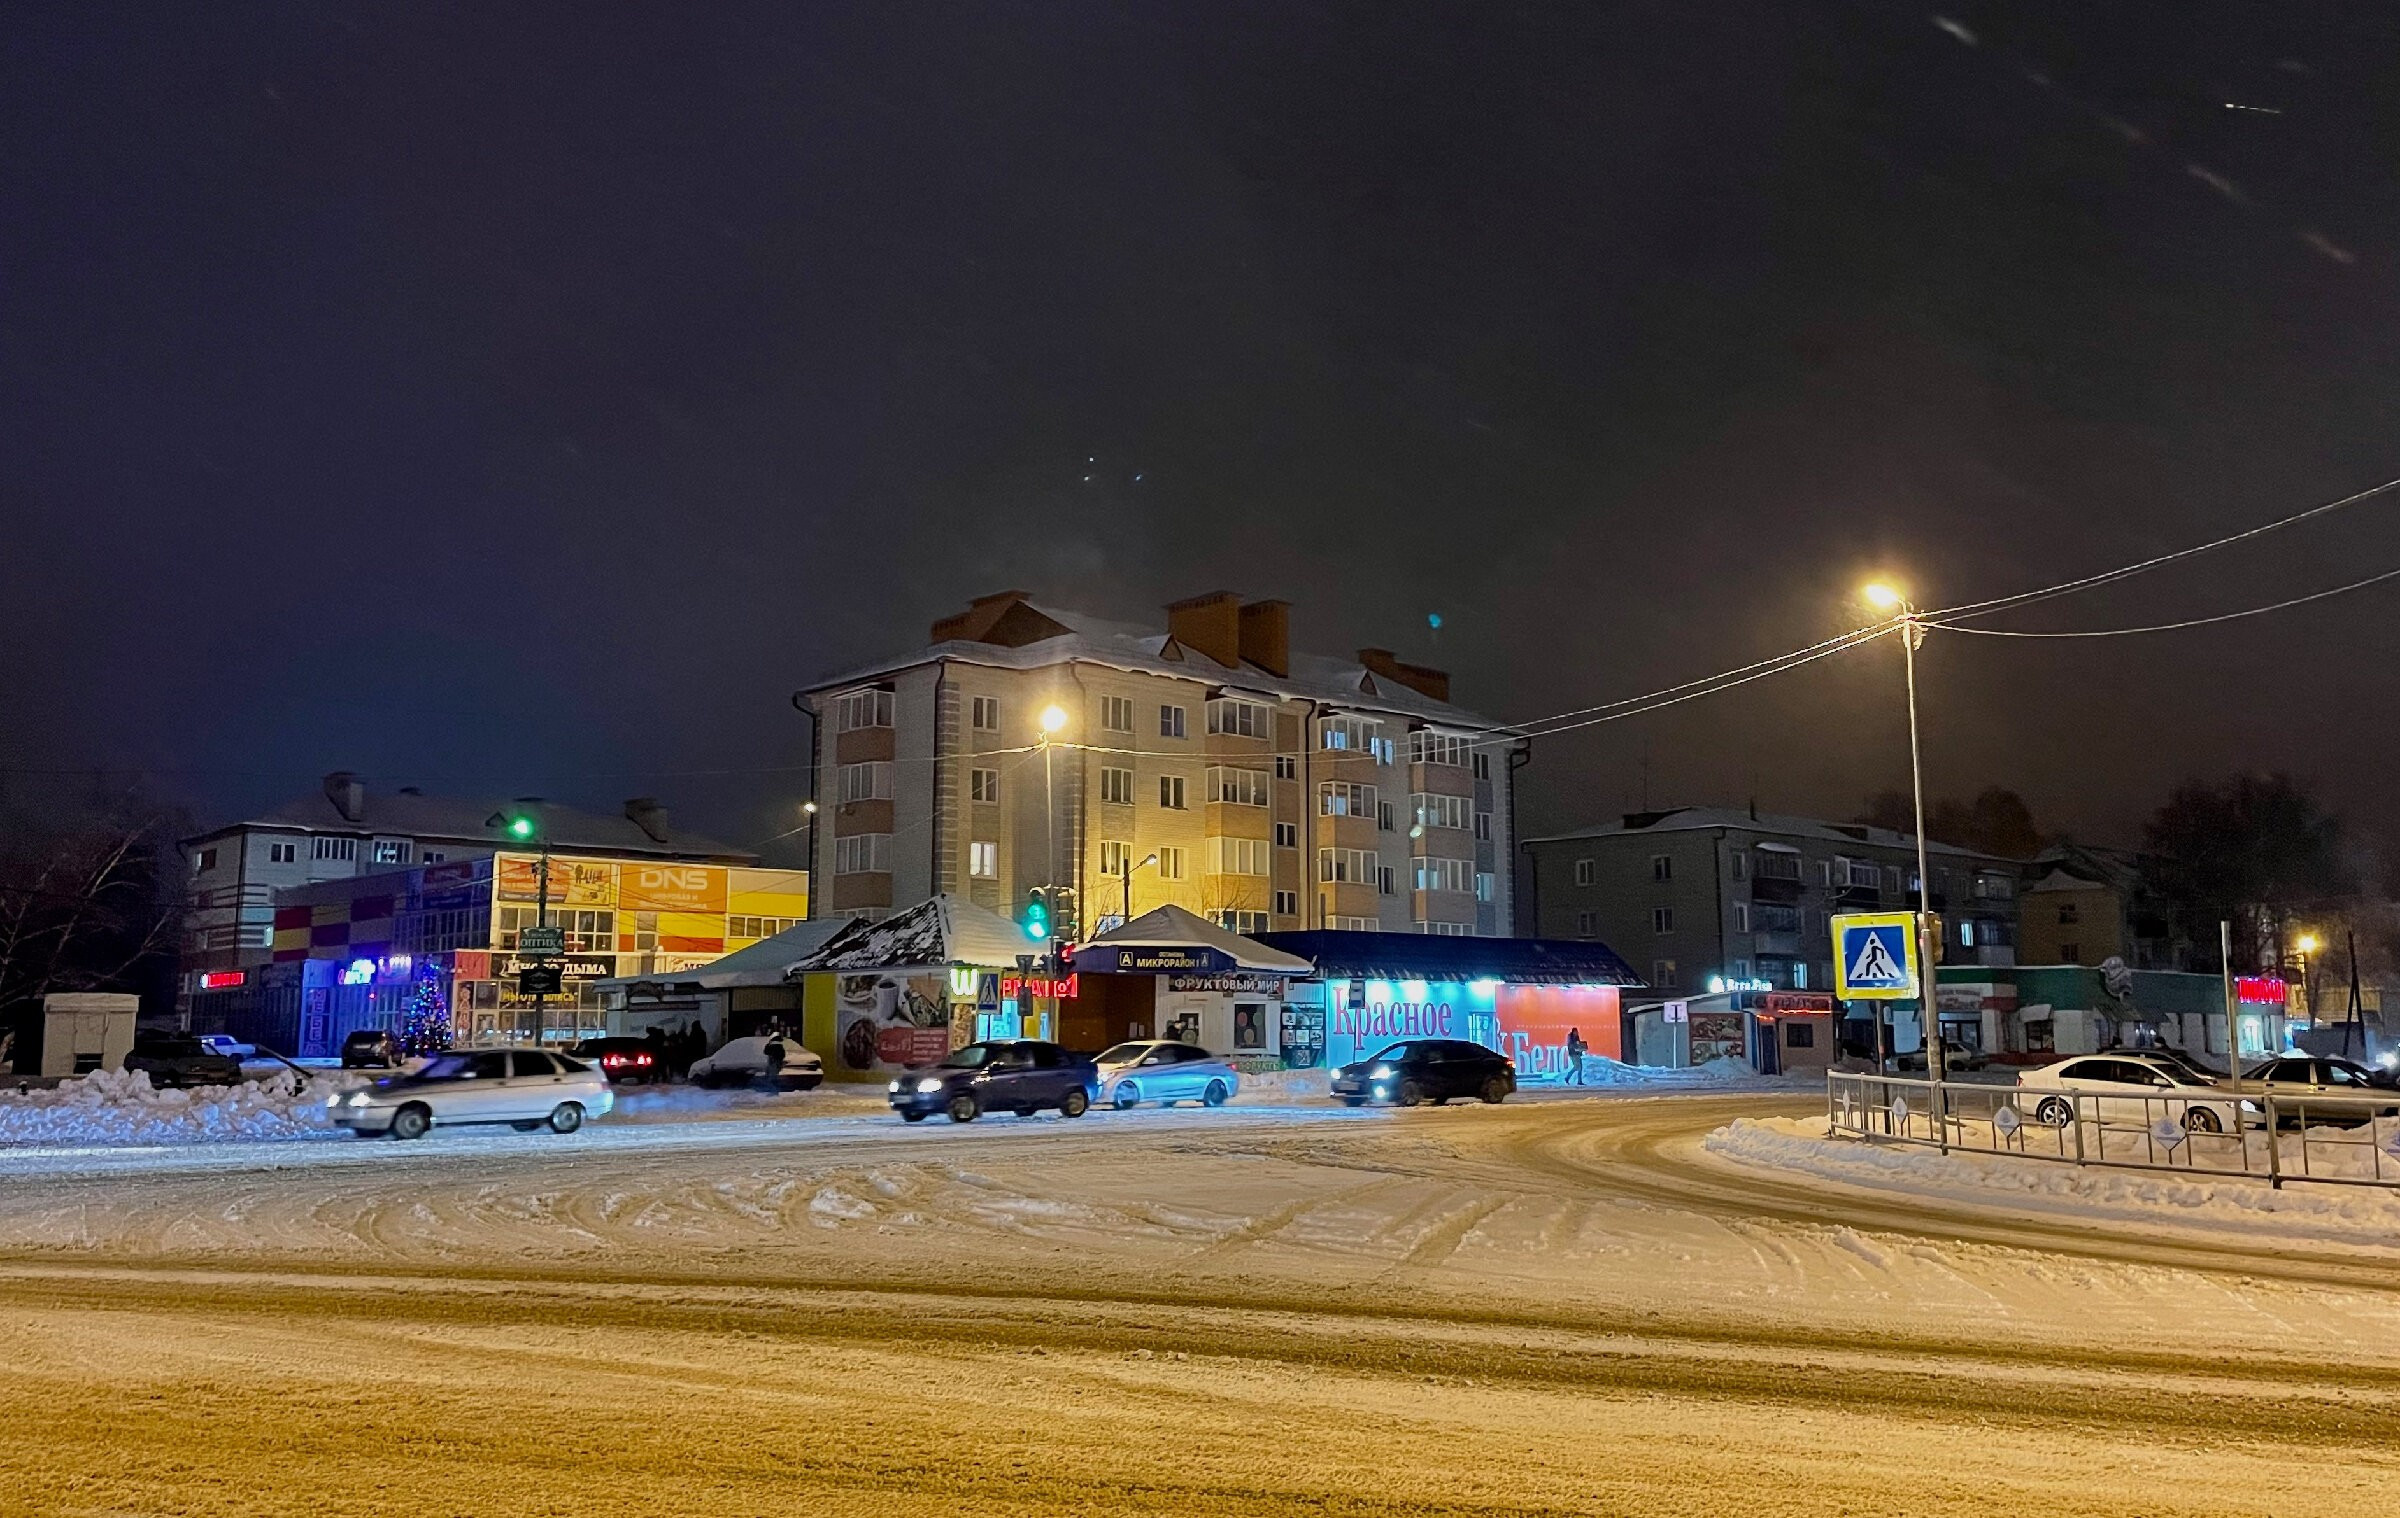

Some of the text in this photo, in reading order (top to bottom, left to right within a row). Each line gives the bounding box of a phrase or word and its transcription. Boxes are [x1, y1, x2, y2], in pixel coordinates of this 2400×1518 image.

[641, 868, 707, 890] DNS
[520, 938, 564, 948] ОПТИКА
[562, 963, 607, 975] ДЫМА
[1136, 957, 1195, 968] МИКРОРАЙОН
[1174, 977, 1280, 992] ФРУКТОВЫЙ МИР
[1333, 987, 1452, 1050] Красное
